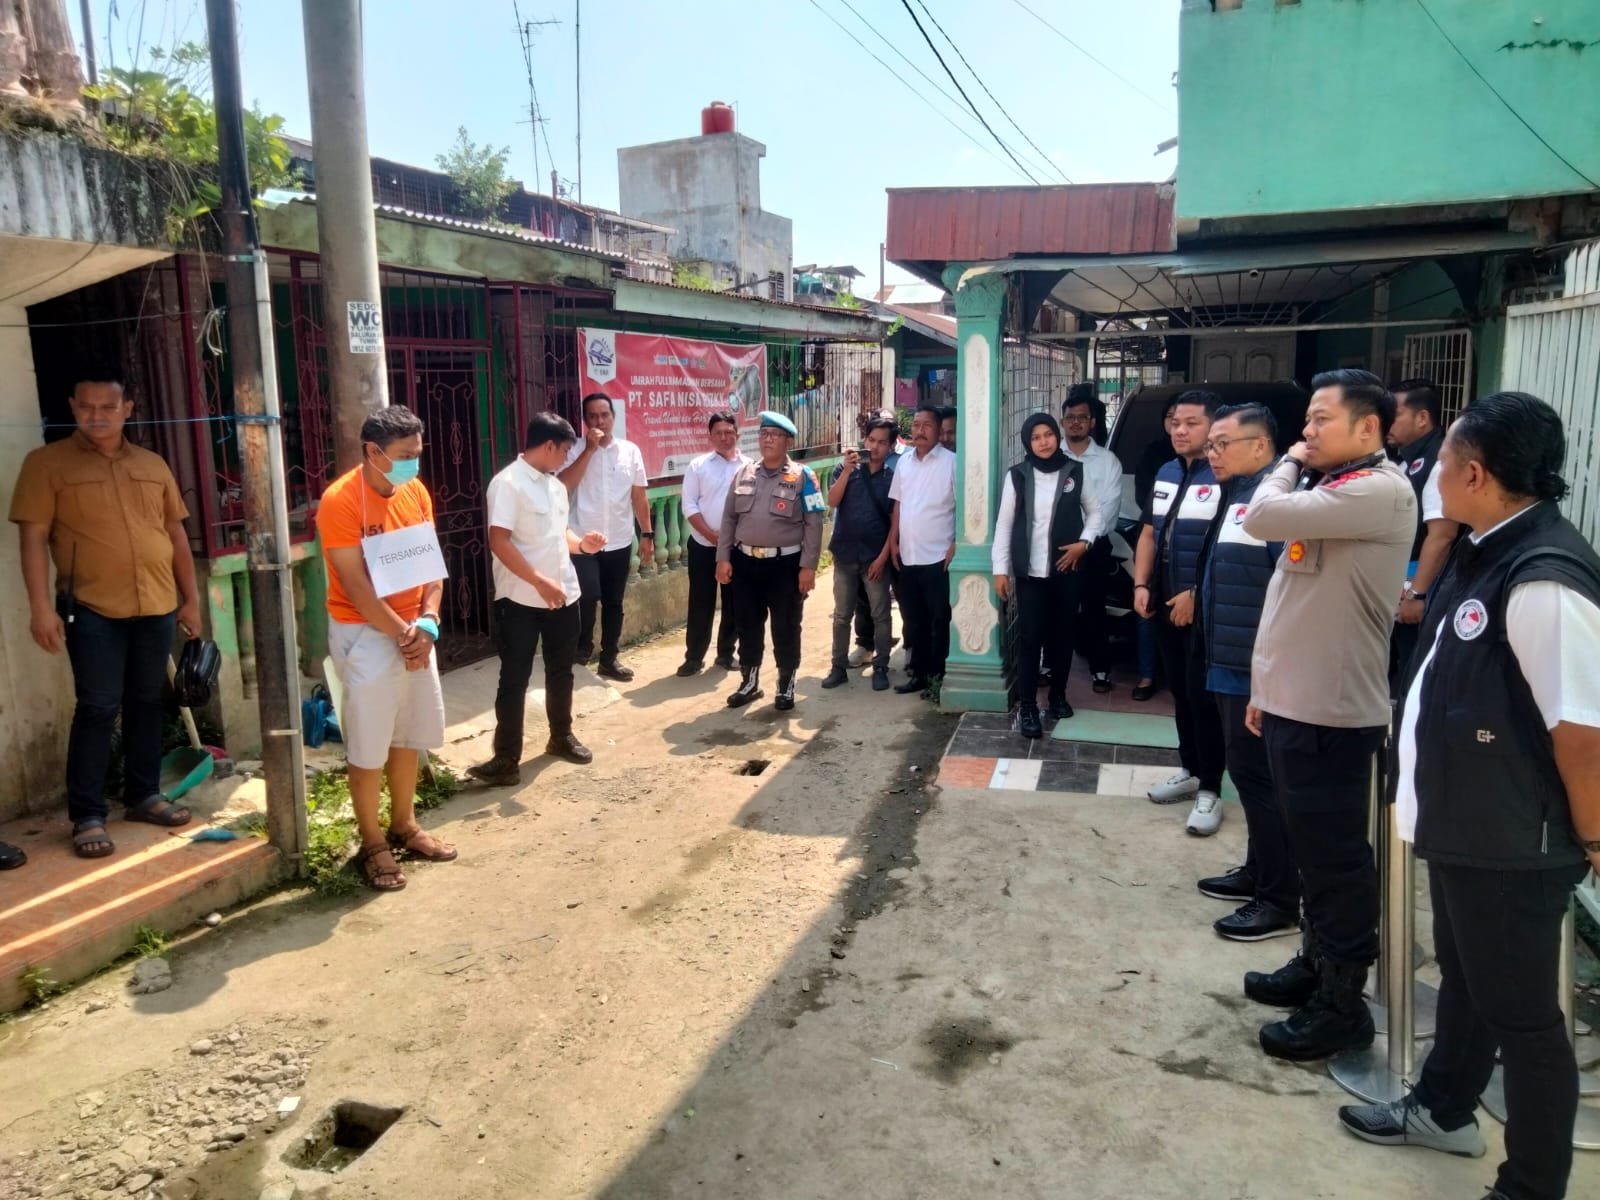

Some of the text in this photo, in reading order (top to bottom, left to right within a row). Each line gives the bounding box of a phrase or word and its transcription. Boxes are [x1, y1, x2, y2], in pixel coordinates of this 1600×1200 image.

[349, 311, 380, 326] WC
[628, 391, 647, 408] PT.
[649, 391, 676, 408] SAFA
[678, 391, 701, 408] NISA
[379, 543, 434, 566] TERSANGKA
